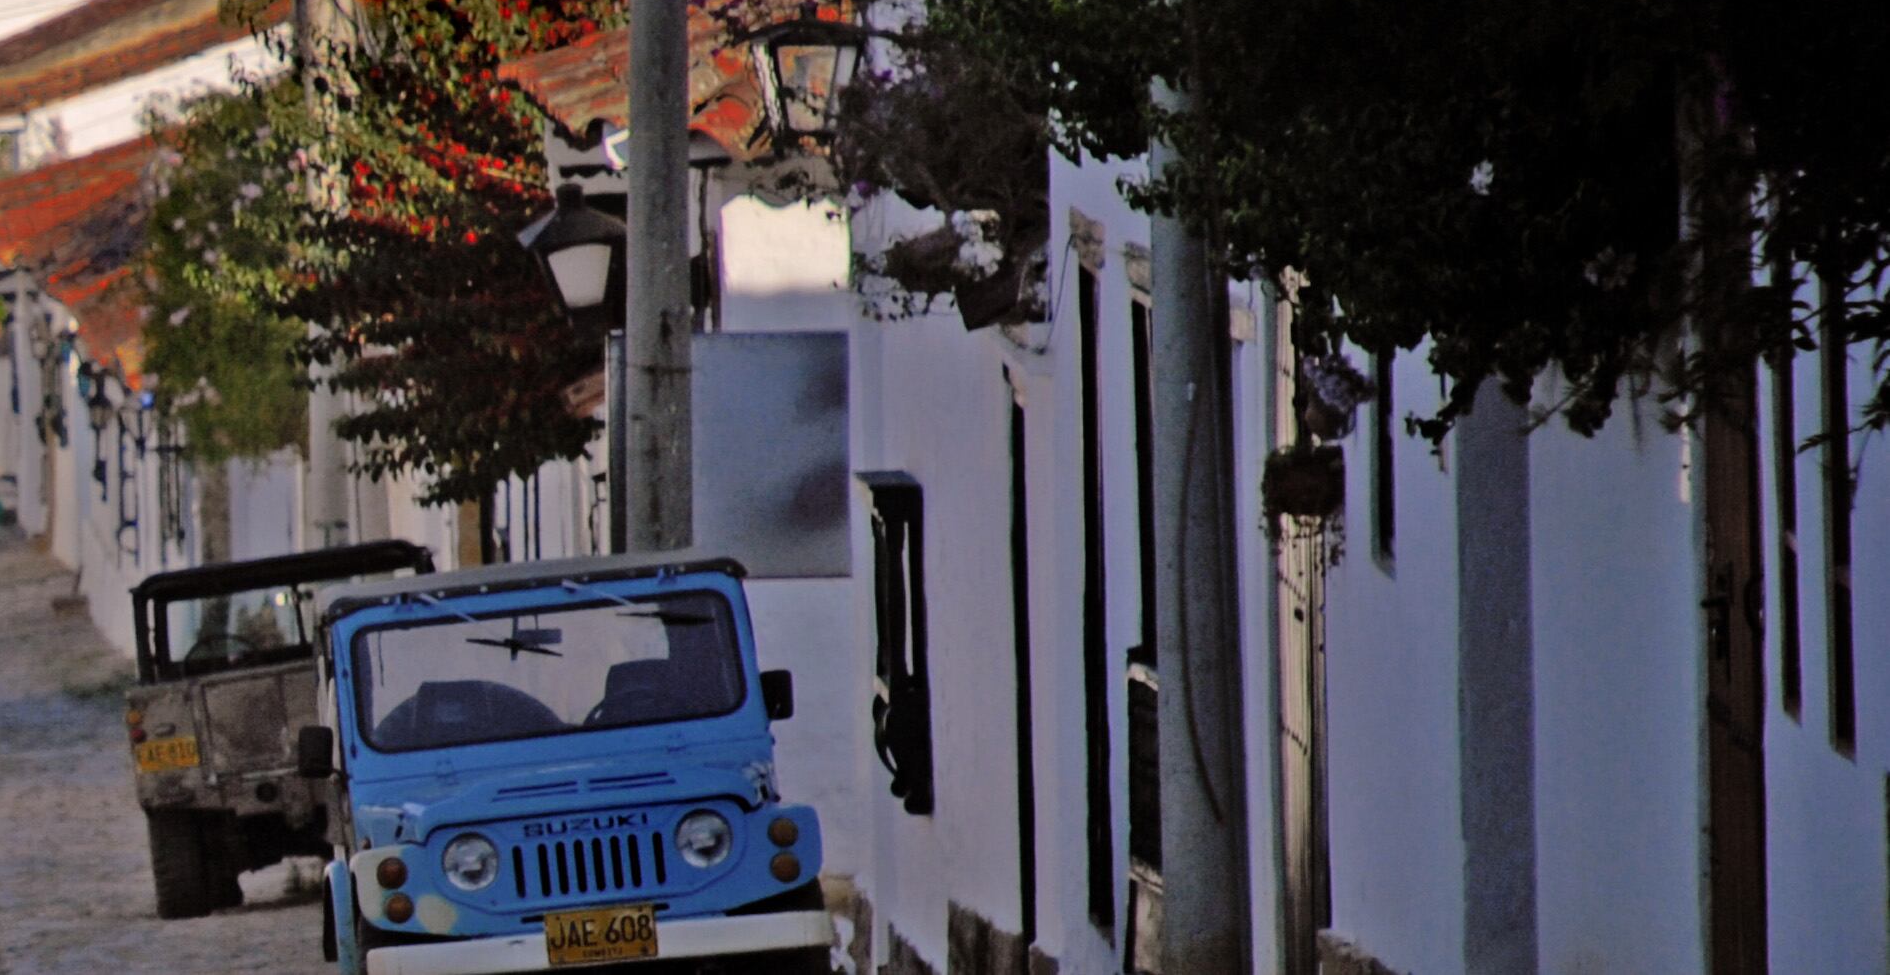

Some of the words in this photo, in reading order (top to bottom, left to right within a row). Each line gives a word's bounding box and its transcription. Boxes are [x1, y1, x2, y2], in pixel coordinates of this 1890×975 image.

[524, 813, 648, 837] SUZUKI
[550, 919, 597, 949] JAE
[605, 914, 653, 944] 608
